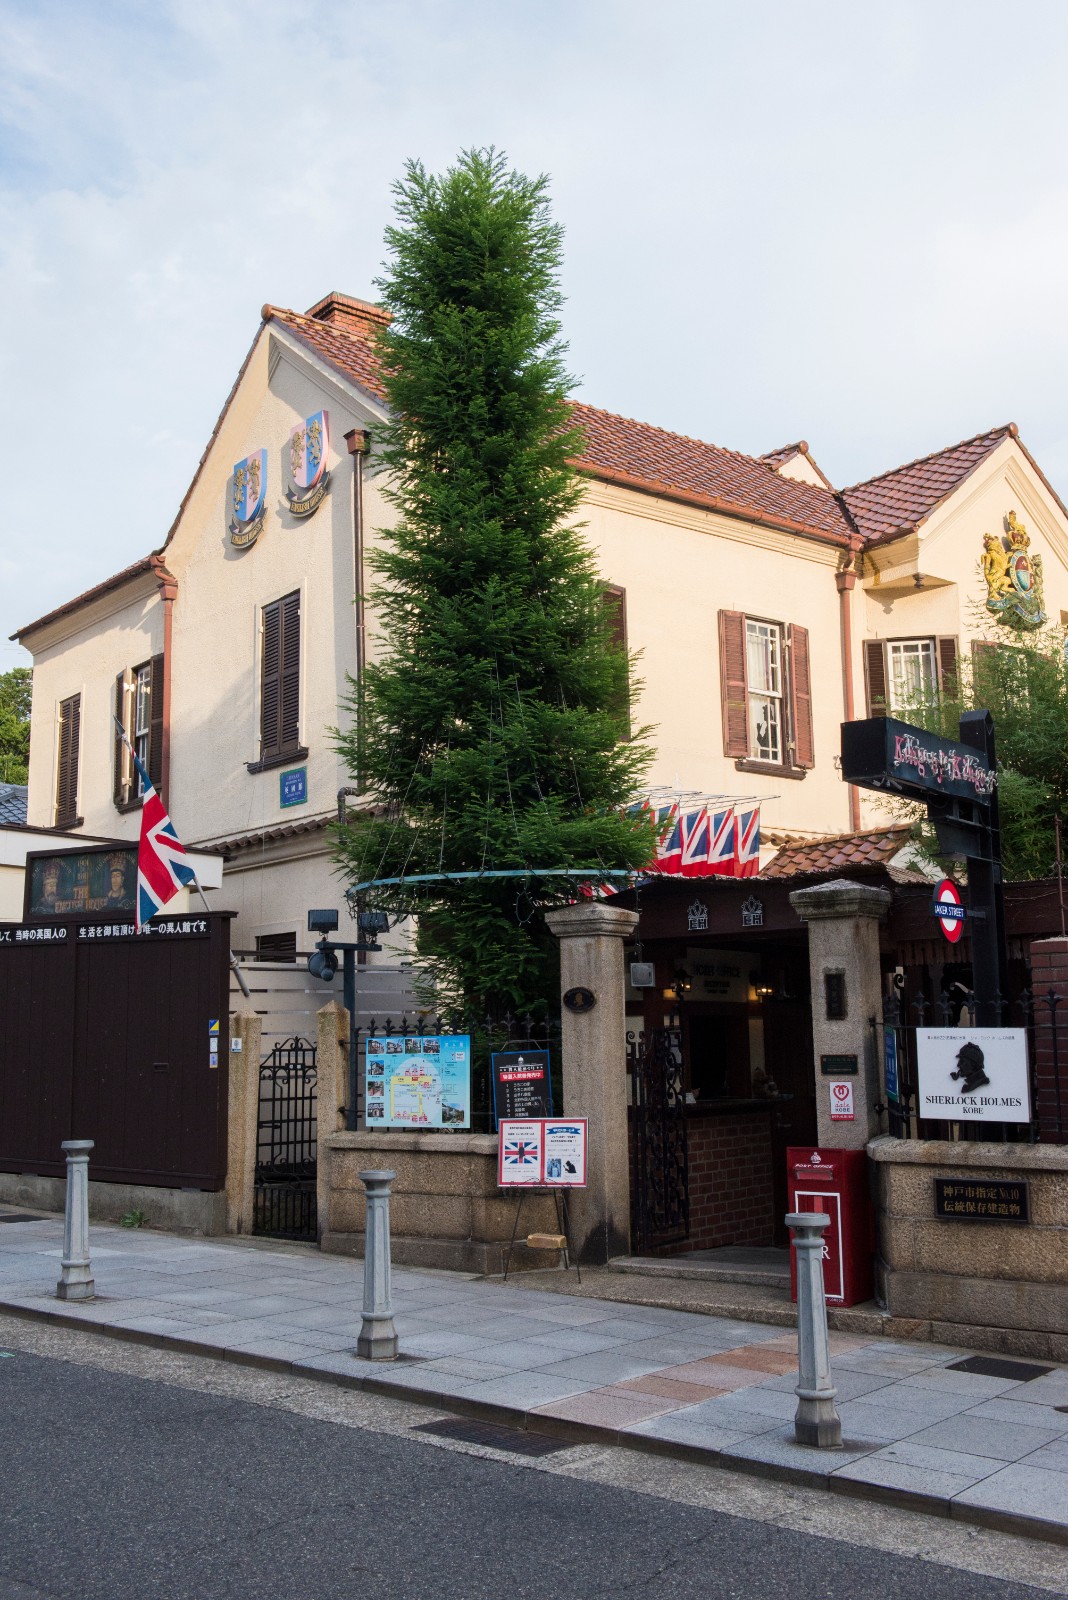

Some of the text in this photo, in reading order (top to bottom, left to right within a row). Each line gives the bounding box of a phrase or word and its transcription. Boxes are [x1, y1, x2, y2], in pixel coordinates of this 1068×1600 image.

[948, 906, 964, 918] STREET
[925, 1095, 1022, 1107] SHERLOCK HOLMES
[962, 1106, 984, 1115] KOBE
[943, 1185, 998, 1199] 神戸市指定
[943, 1200, 1021, 1216] 伝統保存建造物
